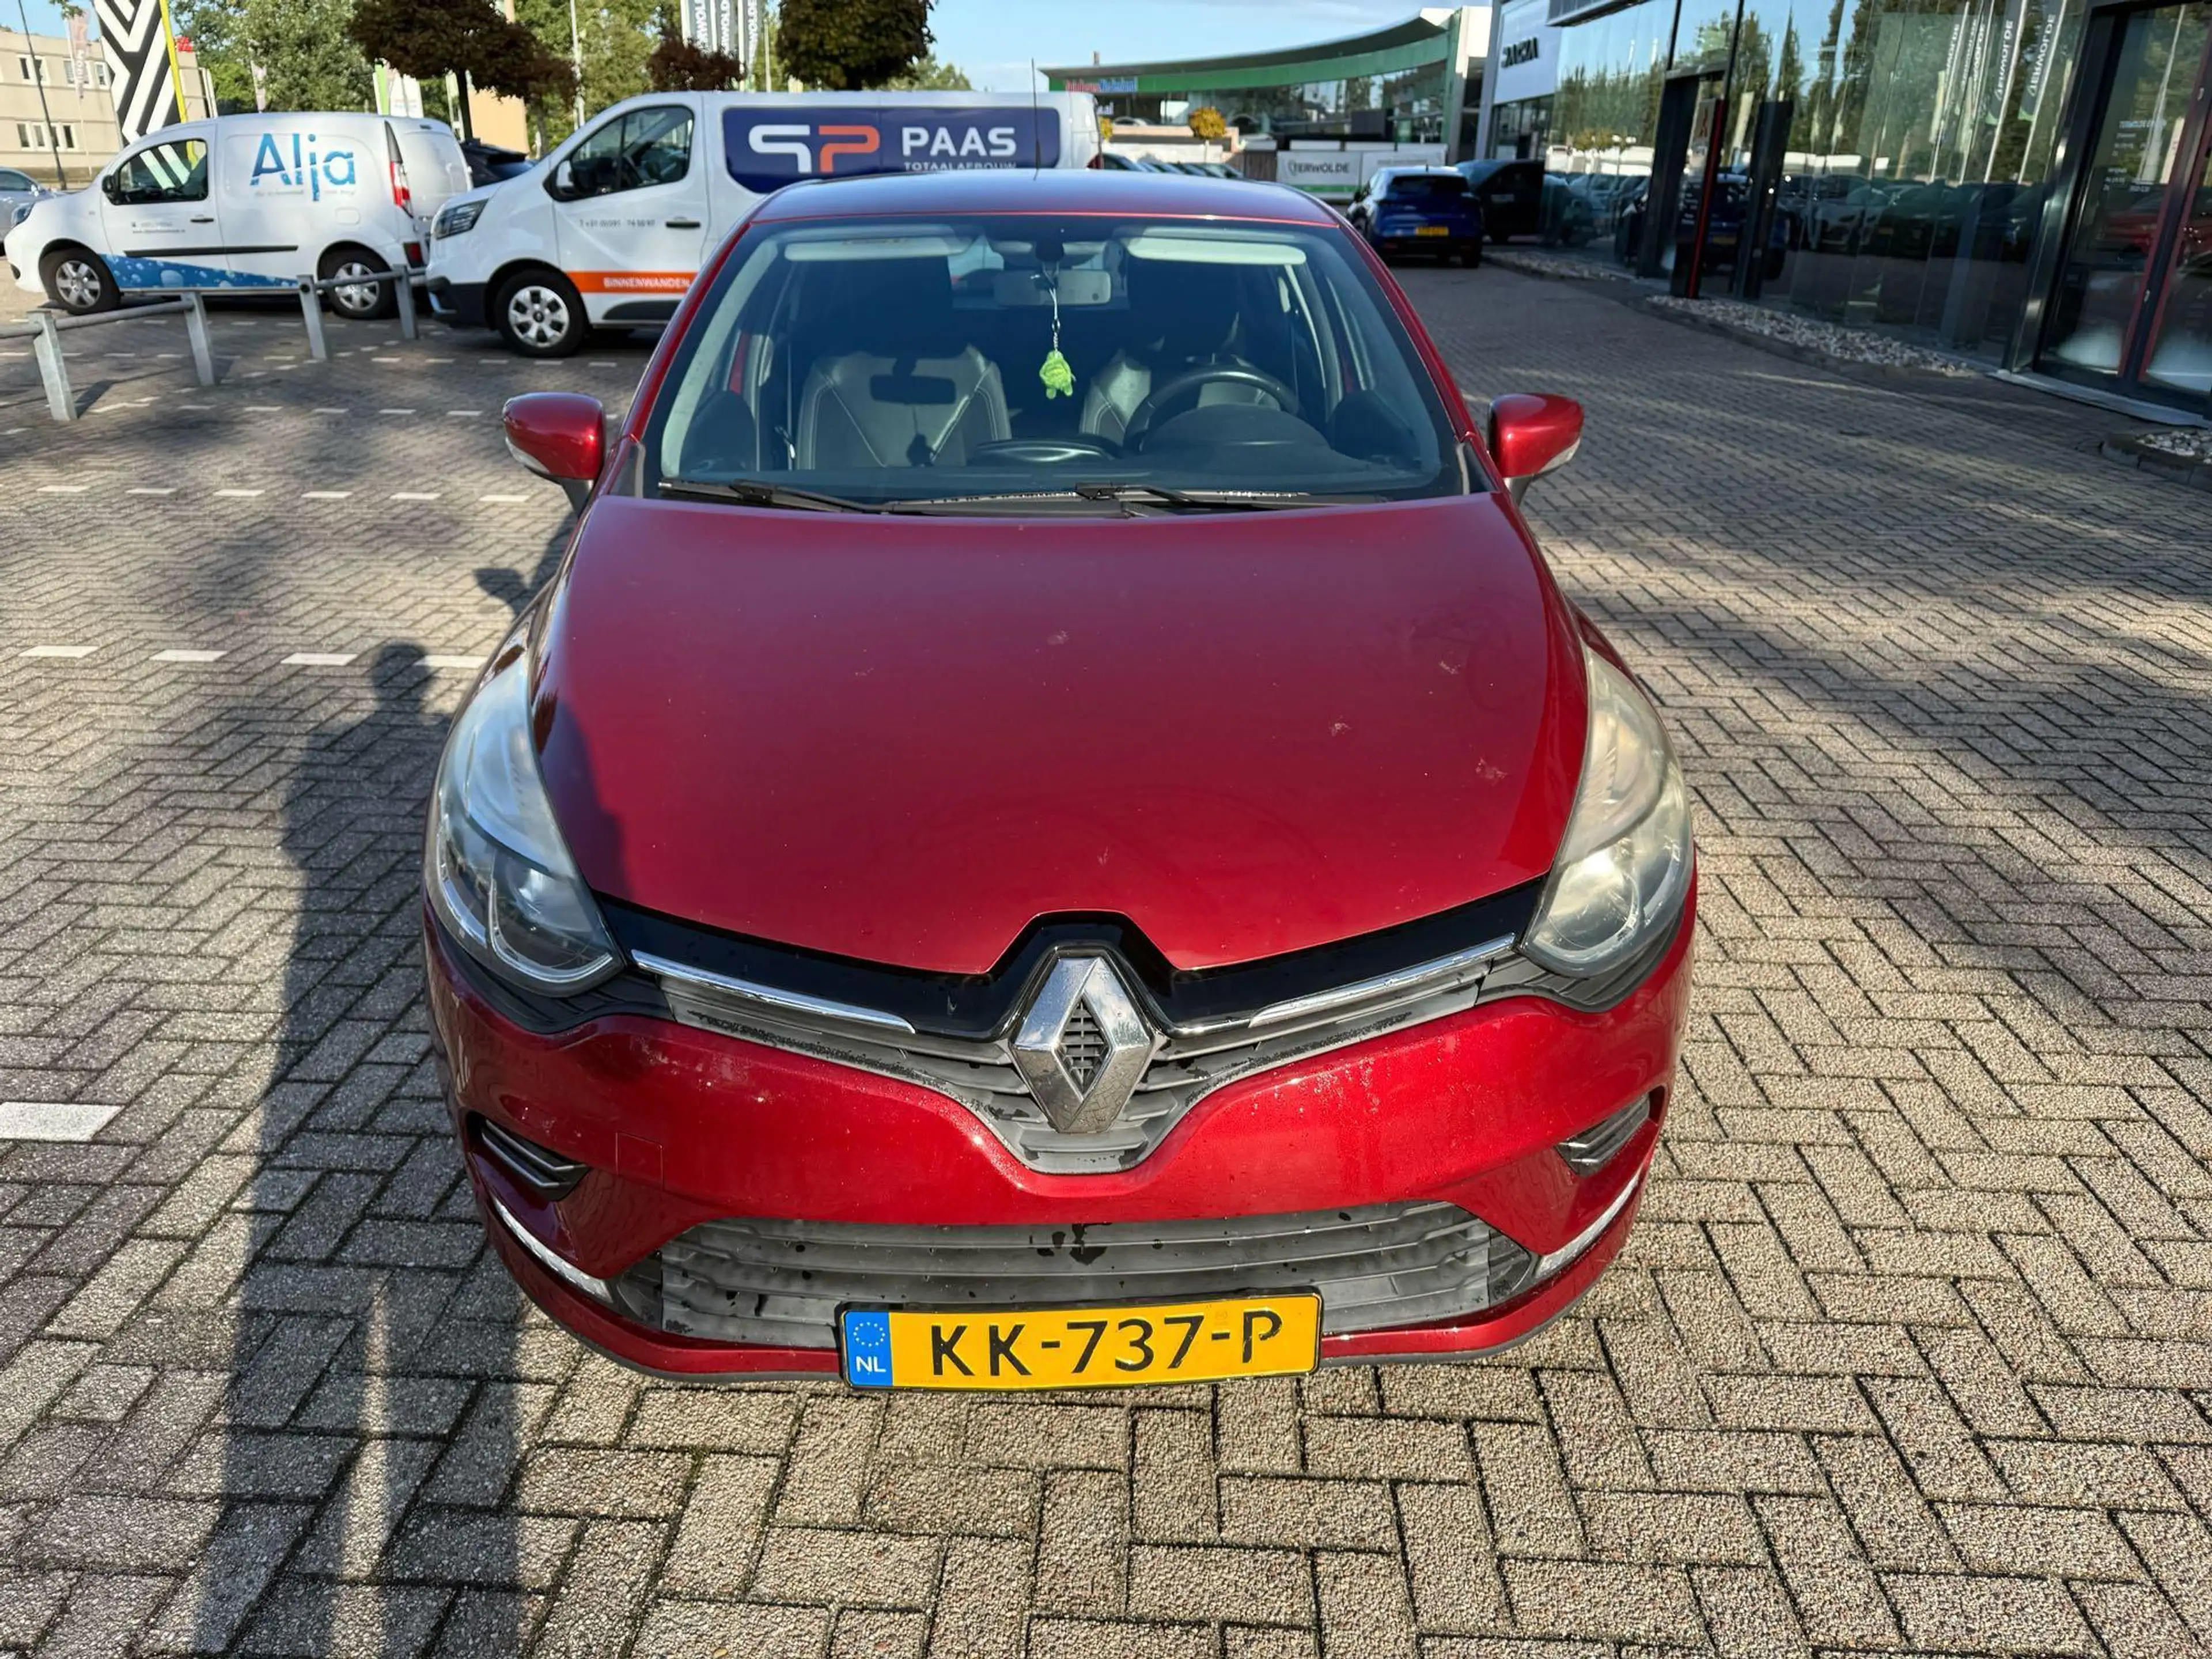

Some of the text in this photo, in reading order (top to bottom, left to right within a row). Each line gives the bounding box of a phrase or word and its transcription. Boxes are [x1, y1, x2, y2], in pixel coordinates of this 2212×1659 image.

[902, 127, 1017, 157] PAAS
[249, 133, 356, 202] Alja
[856, 1356, 887, 1373] NL
[931, 1306, 1283, 1377] KK-737-P
